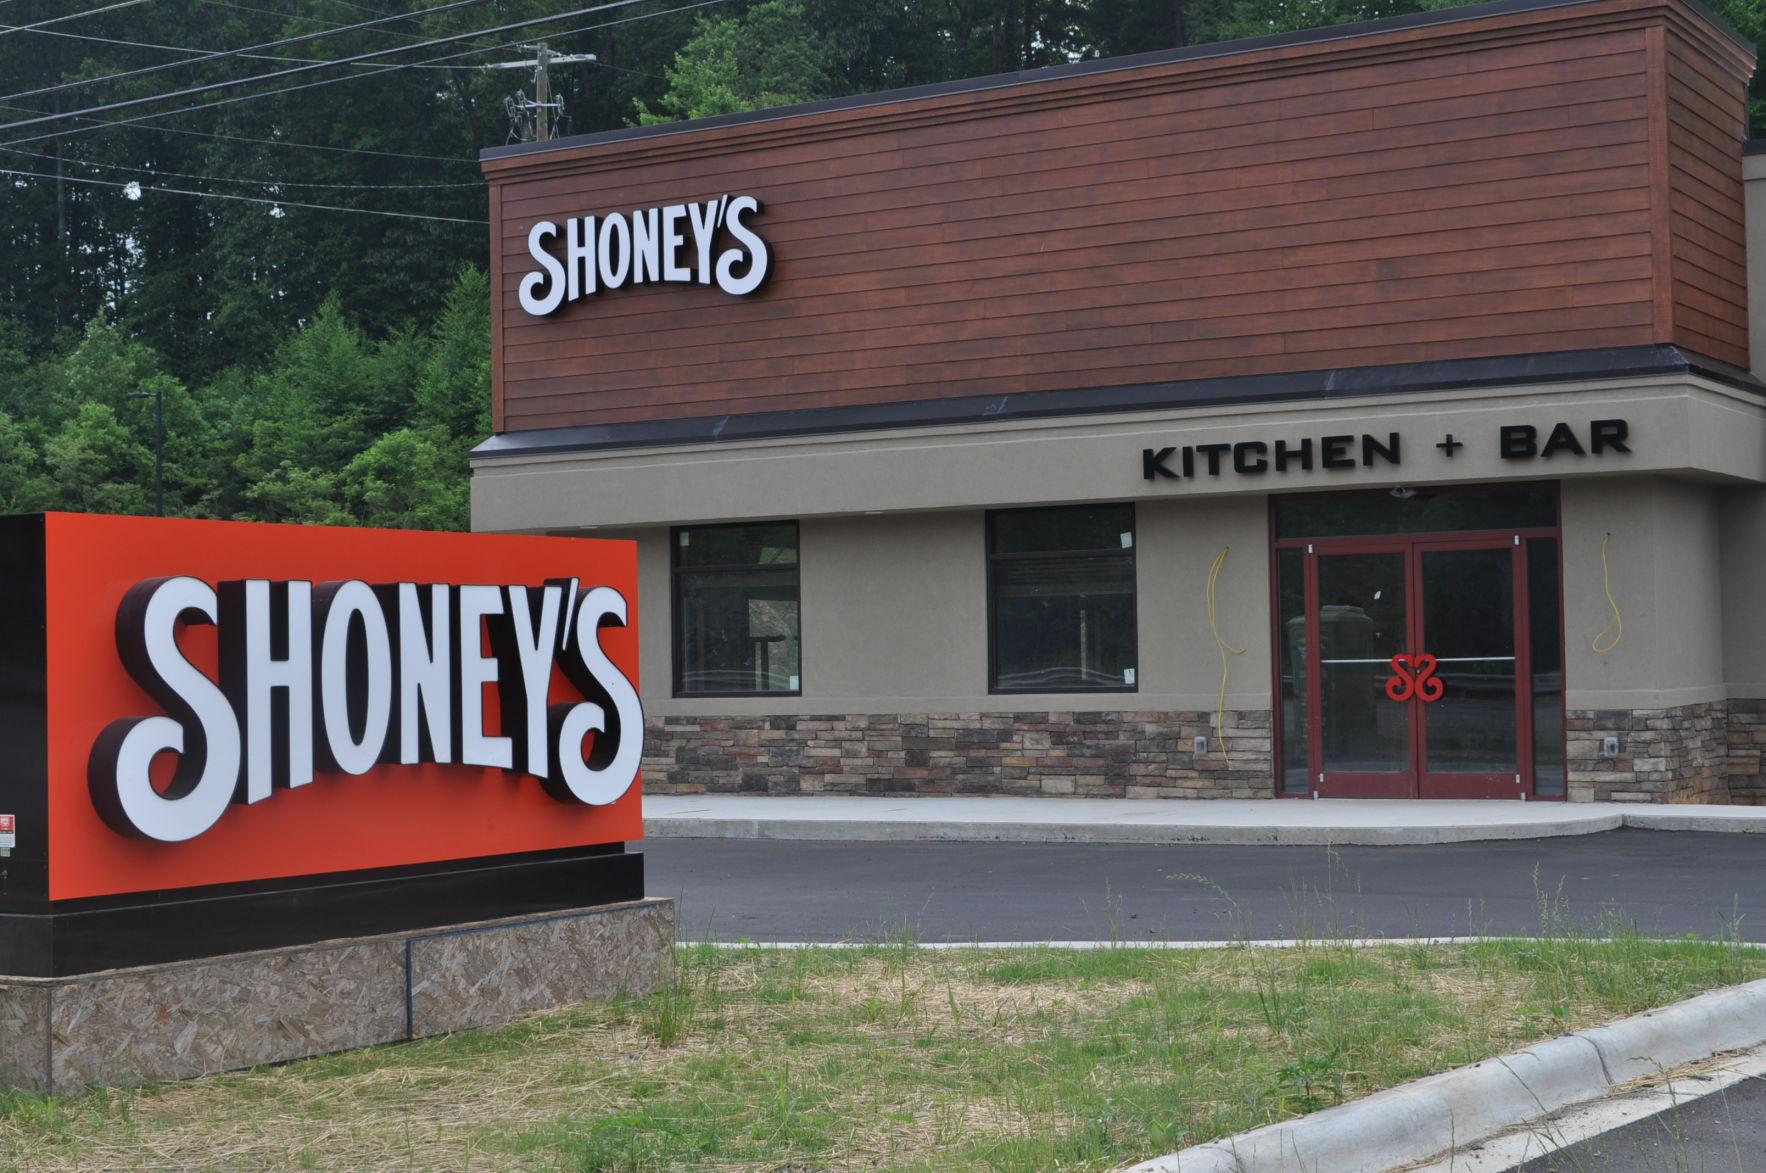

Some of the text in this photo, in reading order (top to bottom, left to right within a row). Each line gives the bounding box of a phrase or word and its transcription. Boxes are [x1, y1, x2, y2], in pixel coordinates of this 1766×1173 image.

[518, 194, 769, 317] SHONEY'S
[1142, 431, 1400, 480] KITCHEN
[1499, 418, 1632, 460] BAR
[115, 575, 645, 843] SHONEY'S
